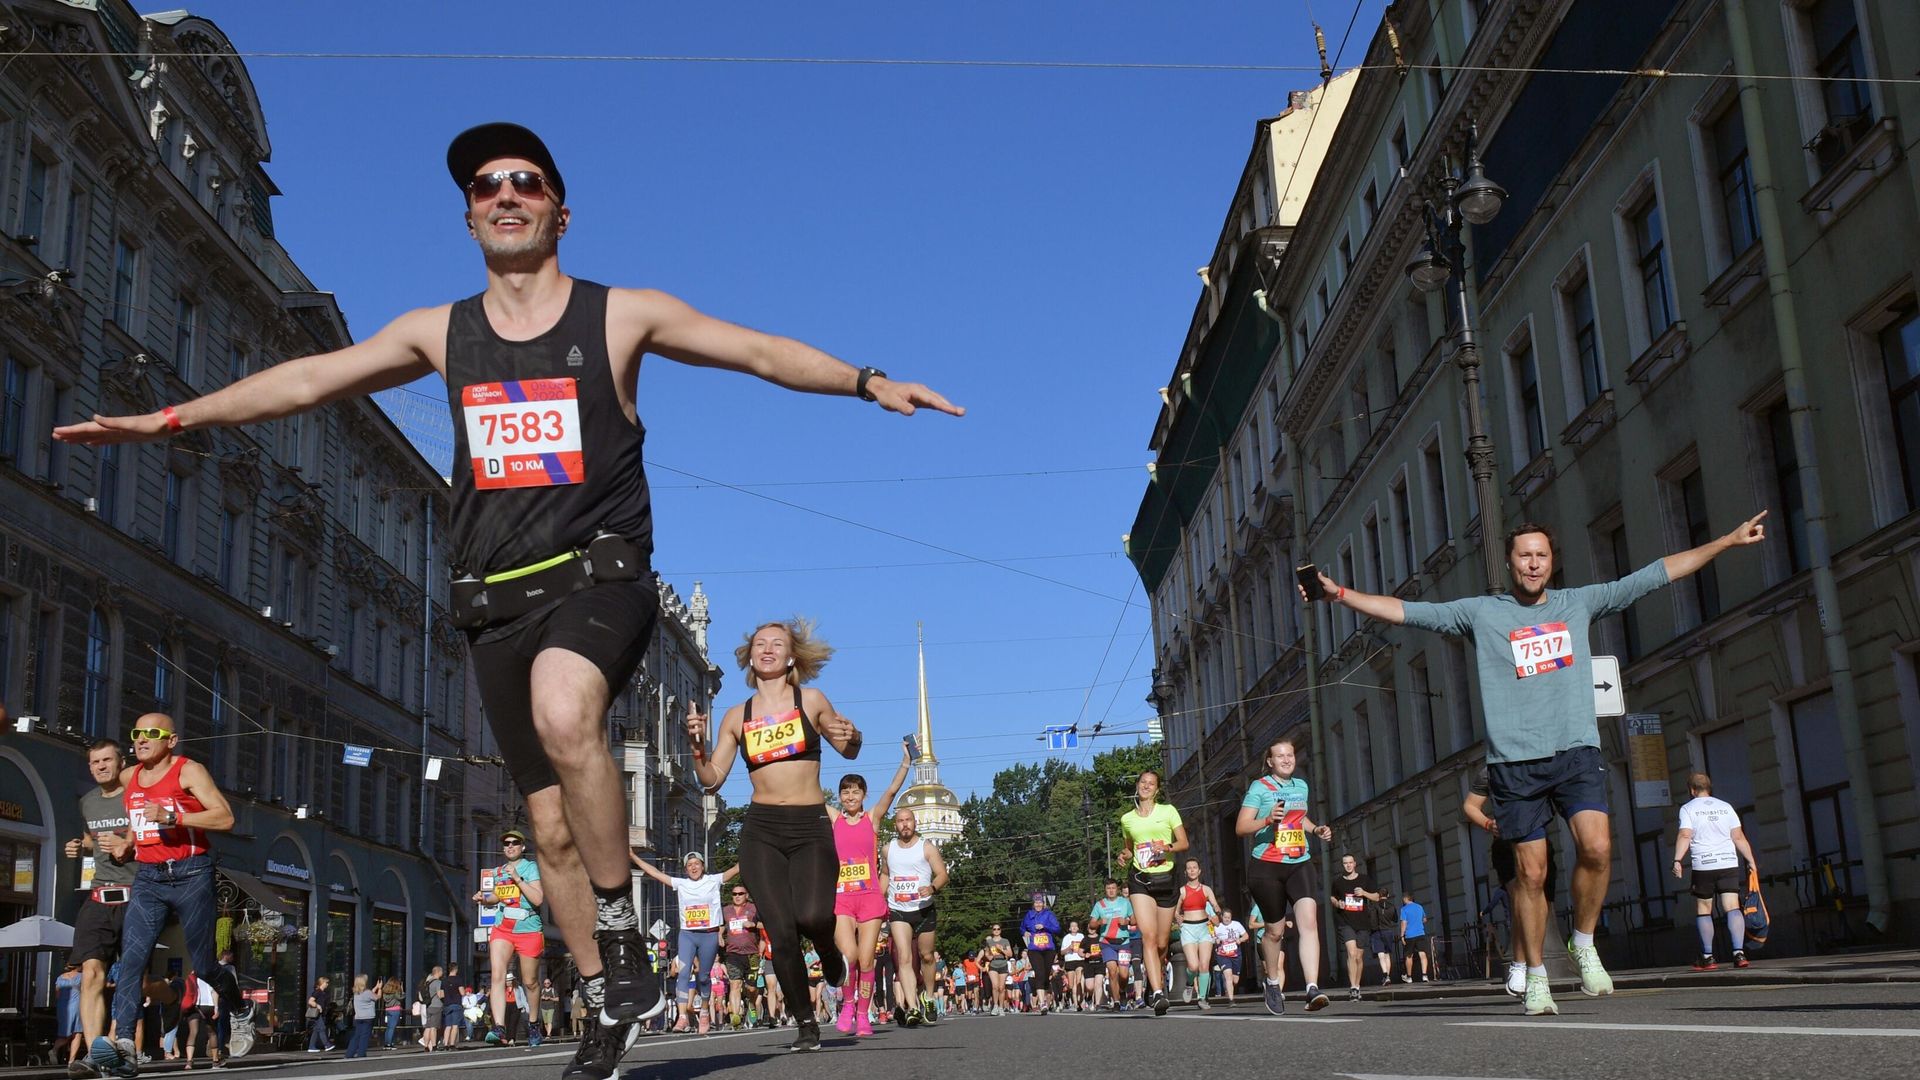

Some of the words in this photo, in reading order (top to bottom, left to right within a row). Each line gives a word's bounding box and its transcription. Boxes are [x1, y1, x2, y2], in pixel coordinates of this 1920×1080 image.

[479, 410, 564, 446] 7583
[489, 458, 500, 474] D
[510, 461, 523, 471] 10
[526, 459, 545, 470] KM
[1520, 636, 1563, 660] 7517
[1526, 665, 1535, 675] D
[752, 722, 795, 746] 7363
[757, 753, 765, 763] E
[1280, 831, 1303, 842] 6798
[840, 865, 865, 877] 6888
[497, 886, 515, 895] 7077
[896, 882, 915, 890] 6699
[687, 910, 706, 918] 7039
